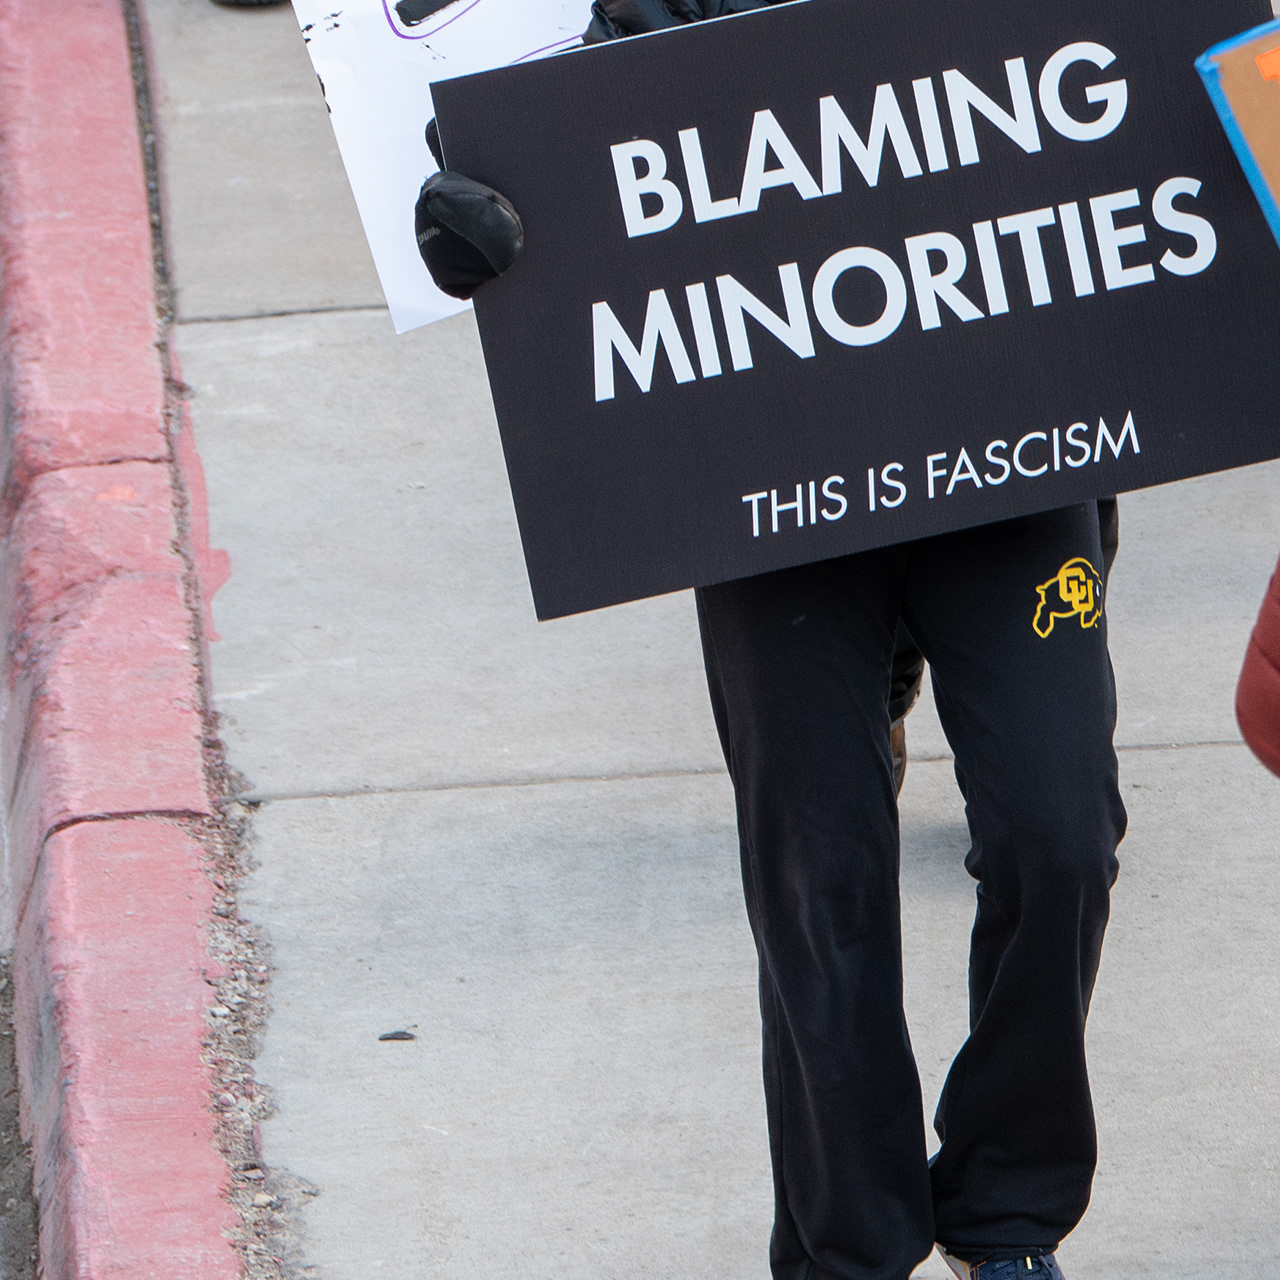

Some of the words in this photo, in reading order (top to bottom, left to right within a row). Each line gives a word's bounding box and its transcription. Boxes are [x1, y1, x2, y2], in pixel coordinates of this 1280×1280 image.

[610, 41, 1128, 238] BLAMING
[592, 176, 1218, 402] MINORITIES
[742, 475, 848, 538] THIS
[867, 462, 908, 512] IS
[926, 410, 1141, 500] FASCISM
